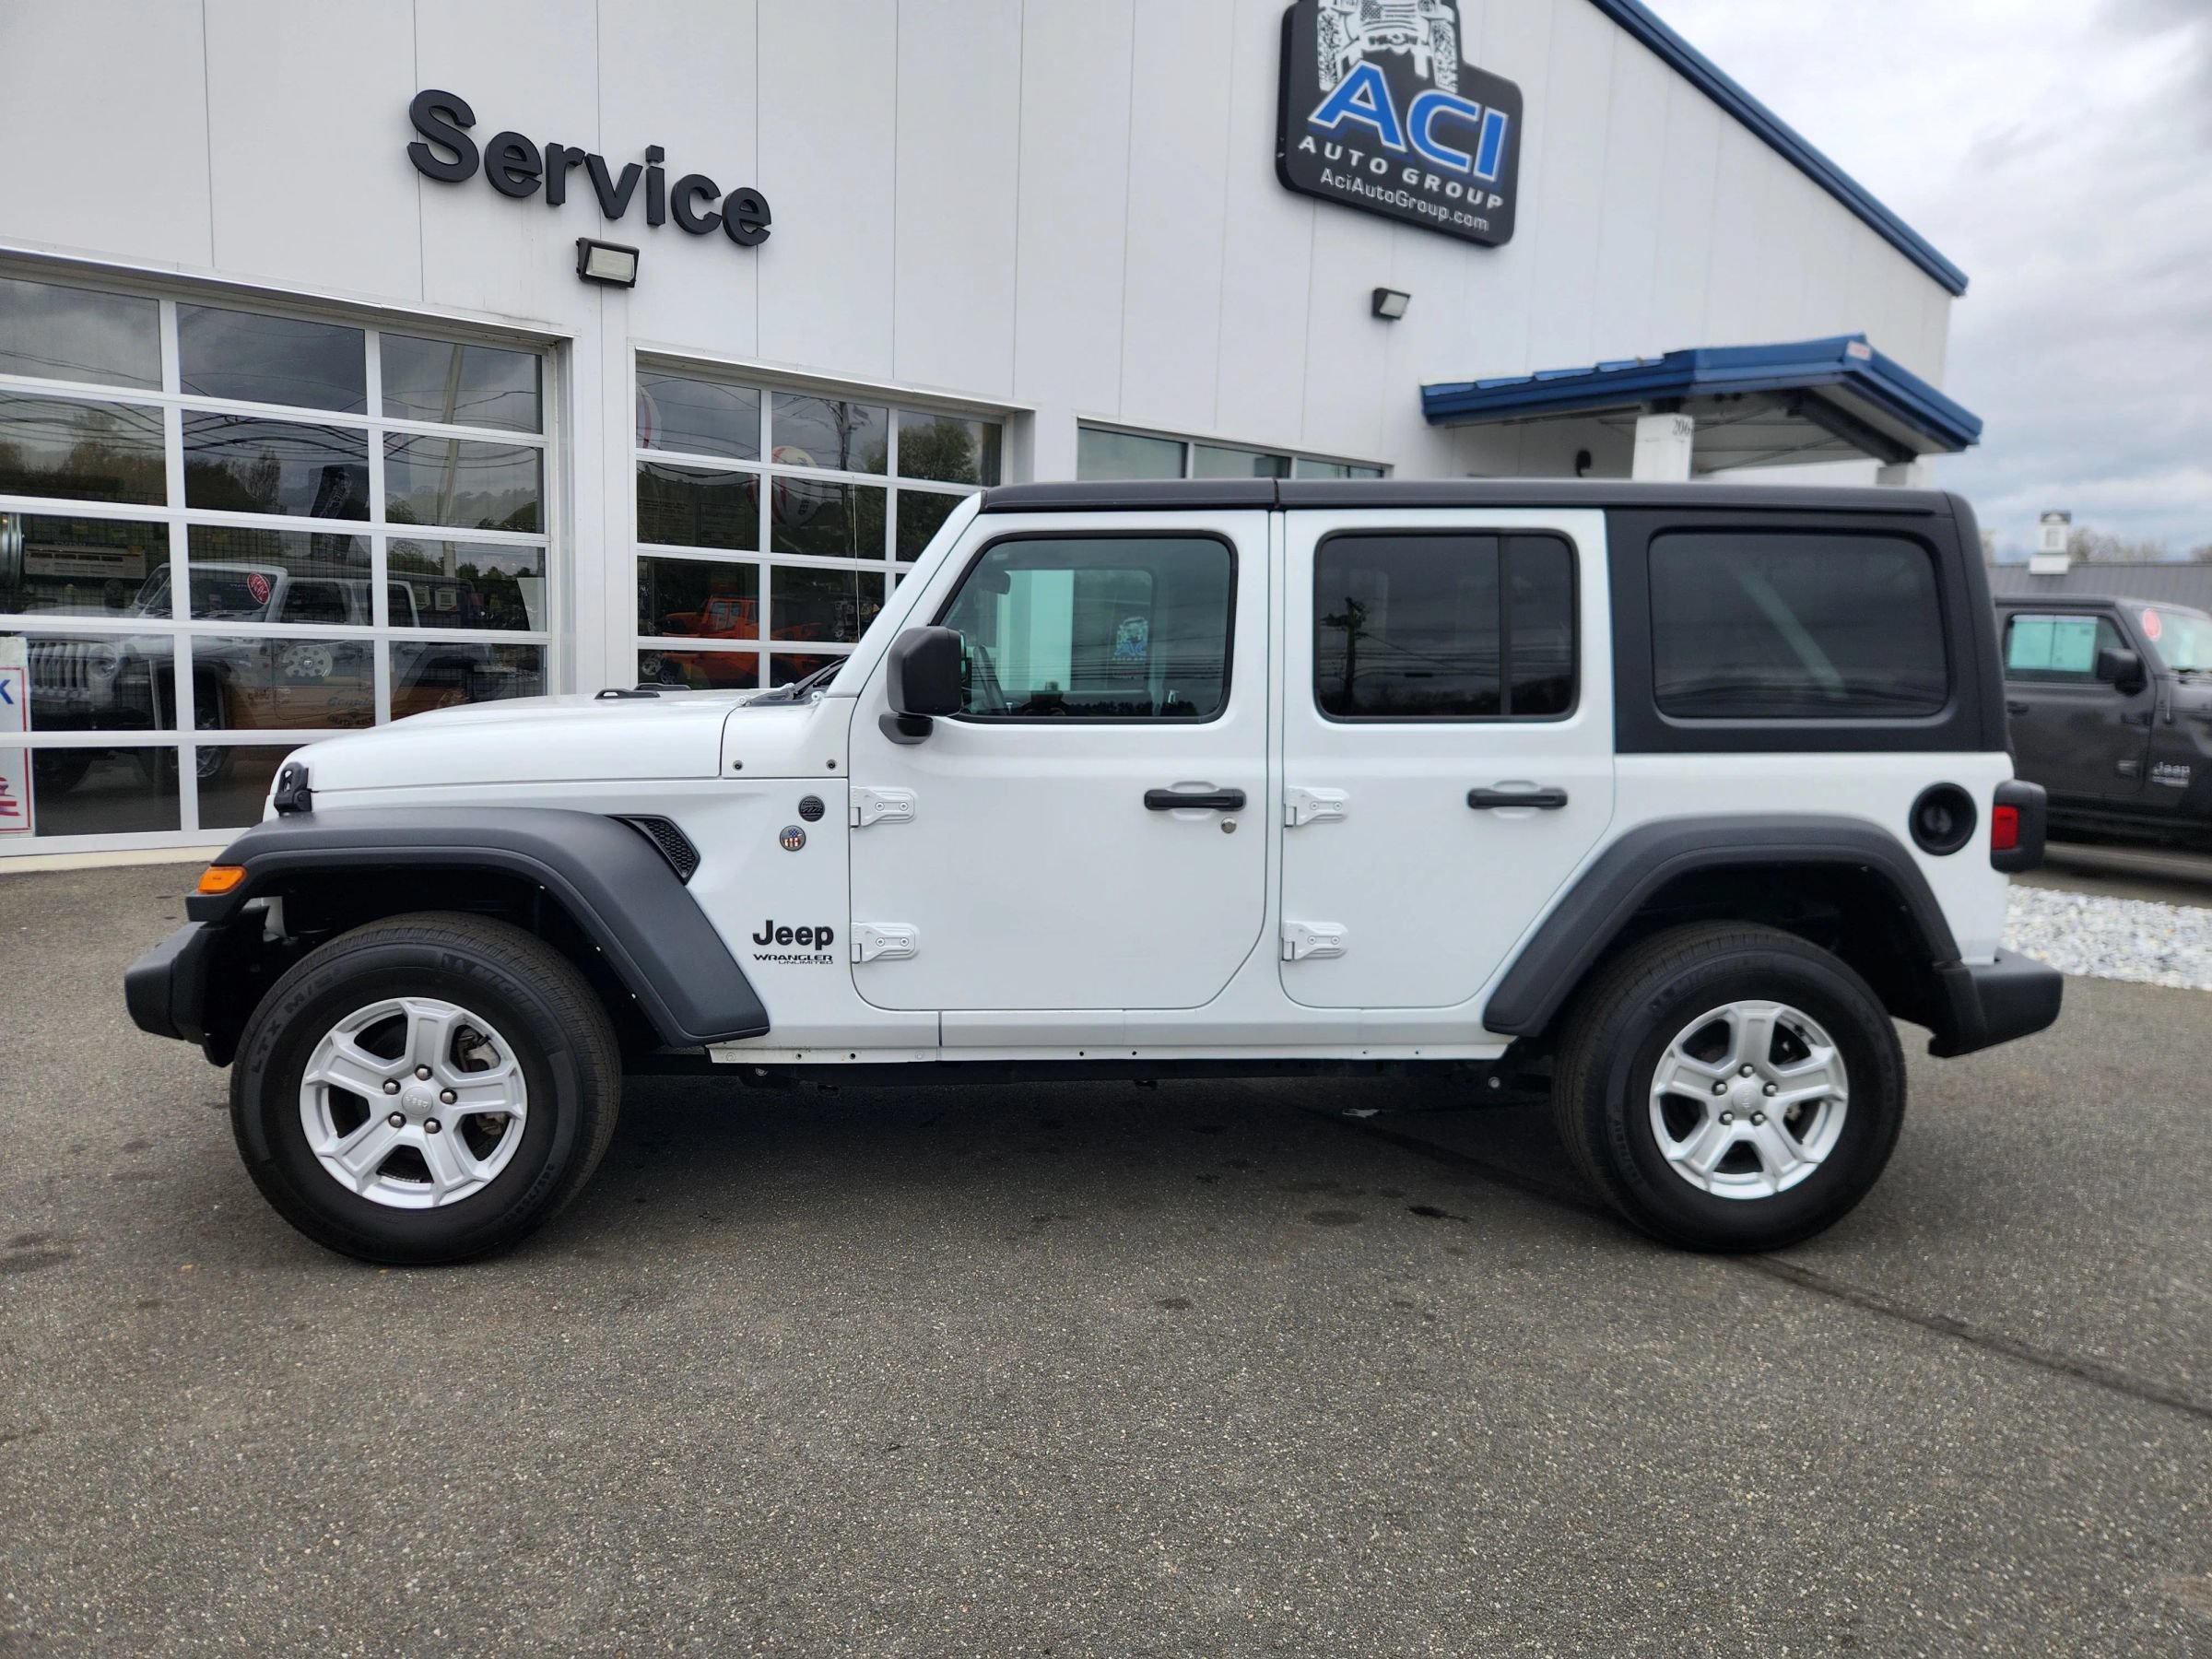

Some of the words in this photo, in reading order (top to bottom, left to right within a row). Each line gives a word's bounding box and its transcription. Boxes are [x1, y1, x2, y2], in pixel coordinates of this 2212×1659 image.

[1307, 60, 1509, 182] ACI
[406, 88, 771, 246] Service
[1298, 135, 1389, 175] AUTO
[1402, 169, 1504, 210] GROUP
[1320, 168, 1490, 232] AciAutoGroup.com
[753, 919, 834, 950] Jeep
